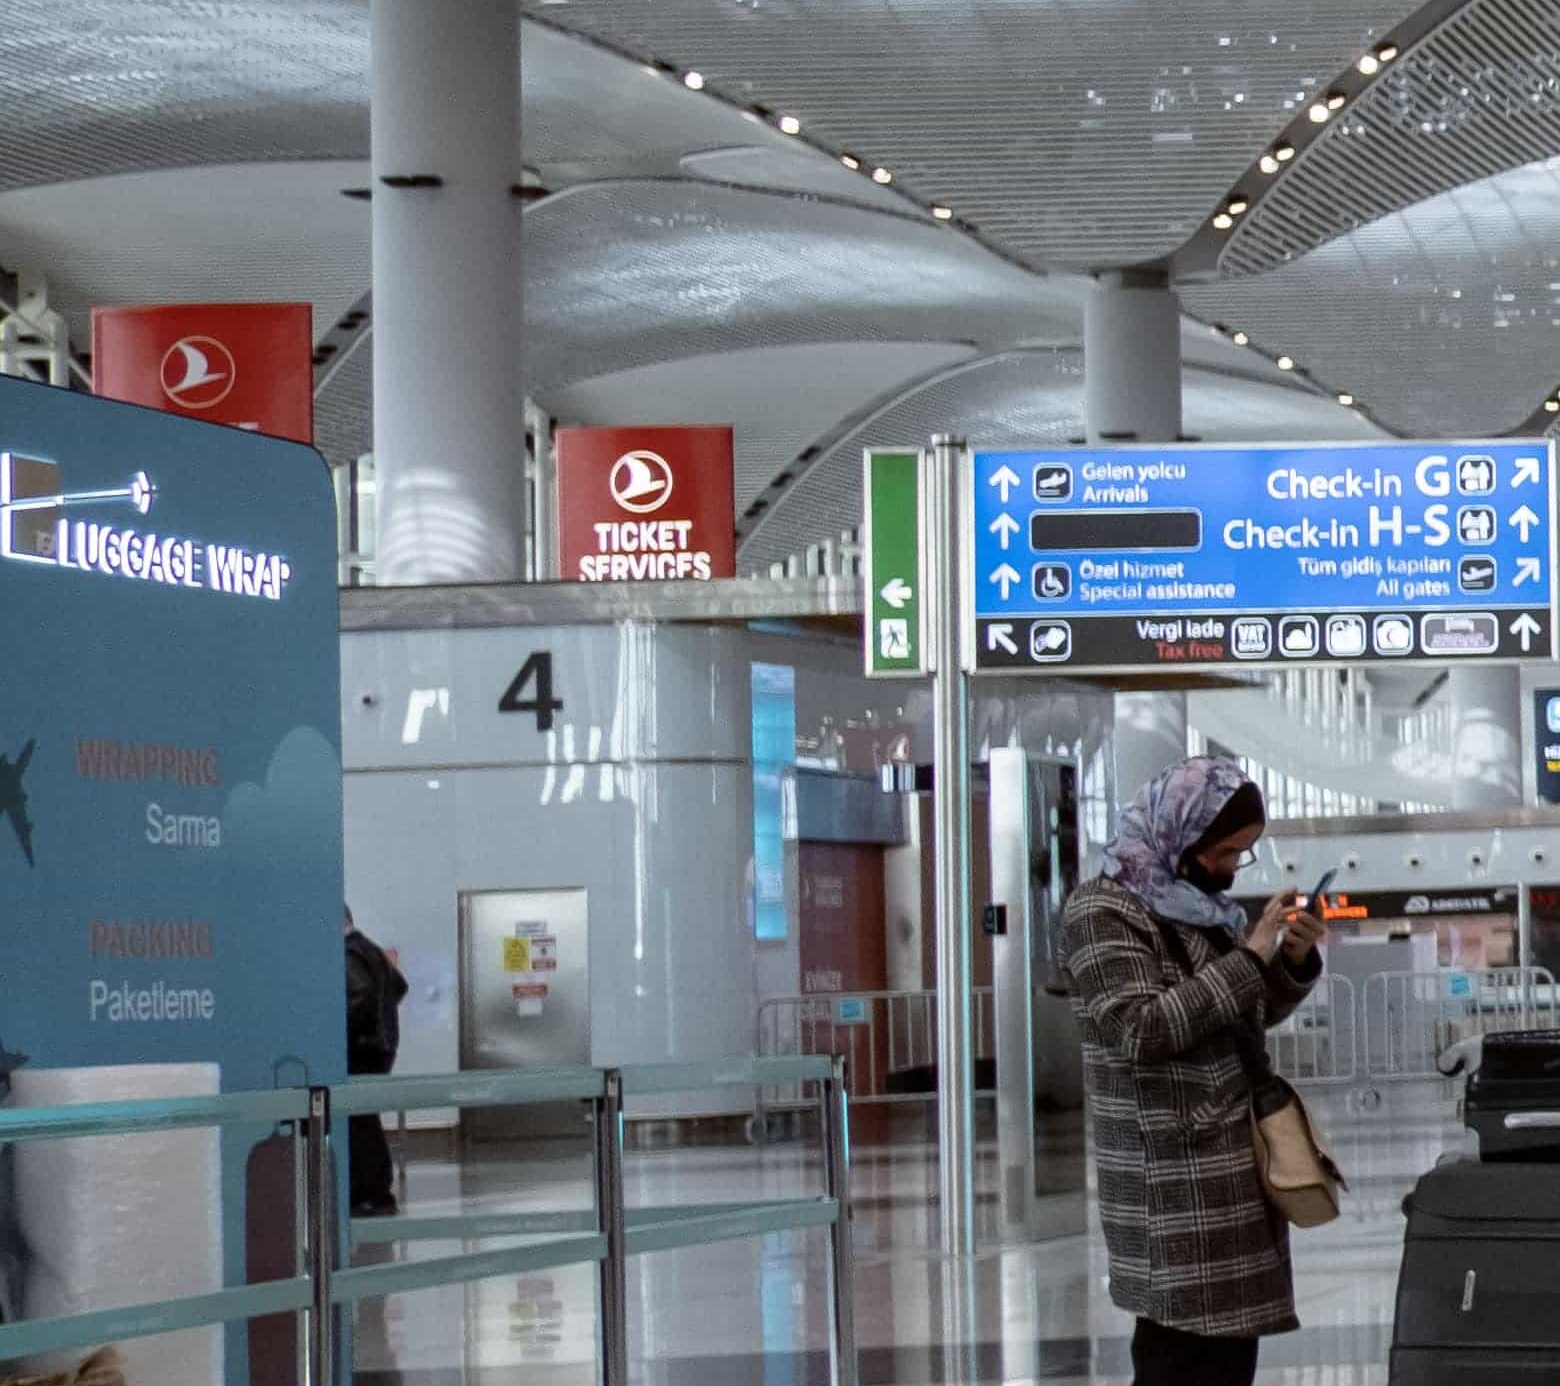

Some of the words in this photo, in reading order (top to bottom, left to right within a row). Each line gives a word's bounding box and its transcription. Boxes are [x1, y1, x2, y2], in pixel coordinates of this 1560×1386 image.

[1081, 461, 1134, 481] Gelen
[1139, 460, 1187, 485] yolcu
[1267, 467, 1403, 500] Check-in
[1414, 455, 1451, 498] G
[1082, 484, 1149, 503] Arrivals
[593, 519, 694, 553] TICKET
[1222, 517, 1360, 550] Check-in
[1368, 503, 1451, 547] H-S
[57, 517, 203, 588] LUGGAGE
[206, 544, 292, 601] WRAP
[579, 552, 712, 581] SERVICES
[1079, 558, 1120, 581] Özel
[1123, 559, 1185, 580] hizmet
[1297, 556, 1338, 576] Tüm
[1079, 581, 1143, 604] Special
[1146, 581, 1236, 600] assistance
[1376, 578, 1399, 598] All
[1403, 579, 1451, 601] gates
[1157, 642, 1185, 660] Tax
[1189, 640, 1224, 660] free
[497, 649, 564, 732] 4
[76, 739, 222, 788] WRAPPING
[145, 803, 221, 847] Sarma
[88, 919, 215, 958] PACKING
[88, 980, 216, 1022] Paketleme
